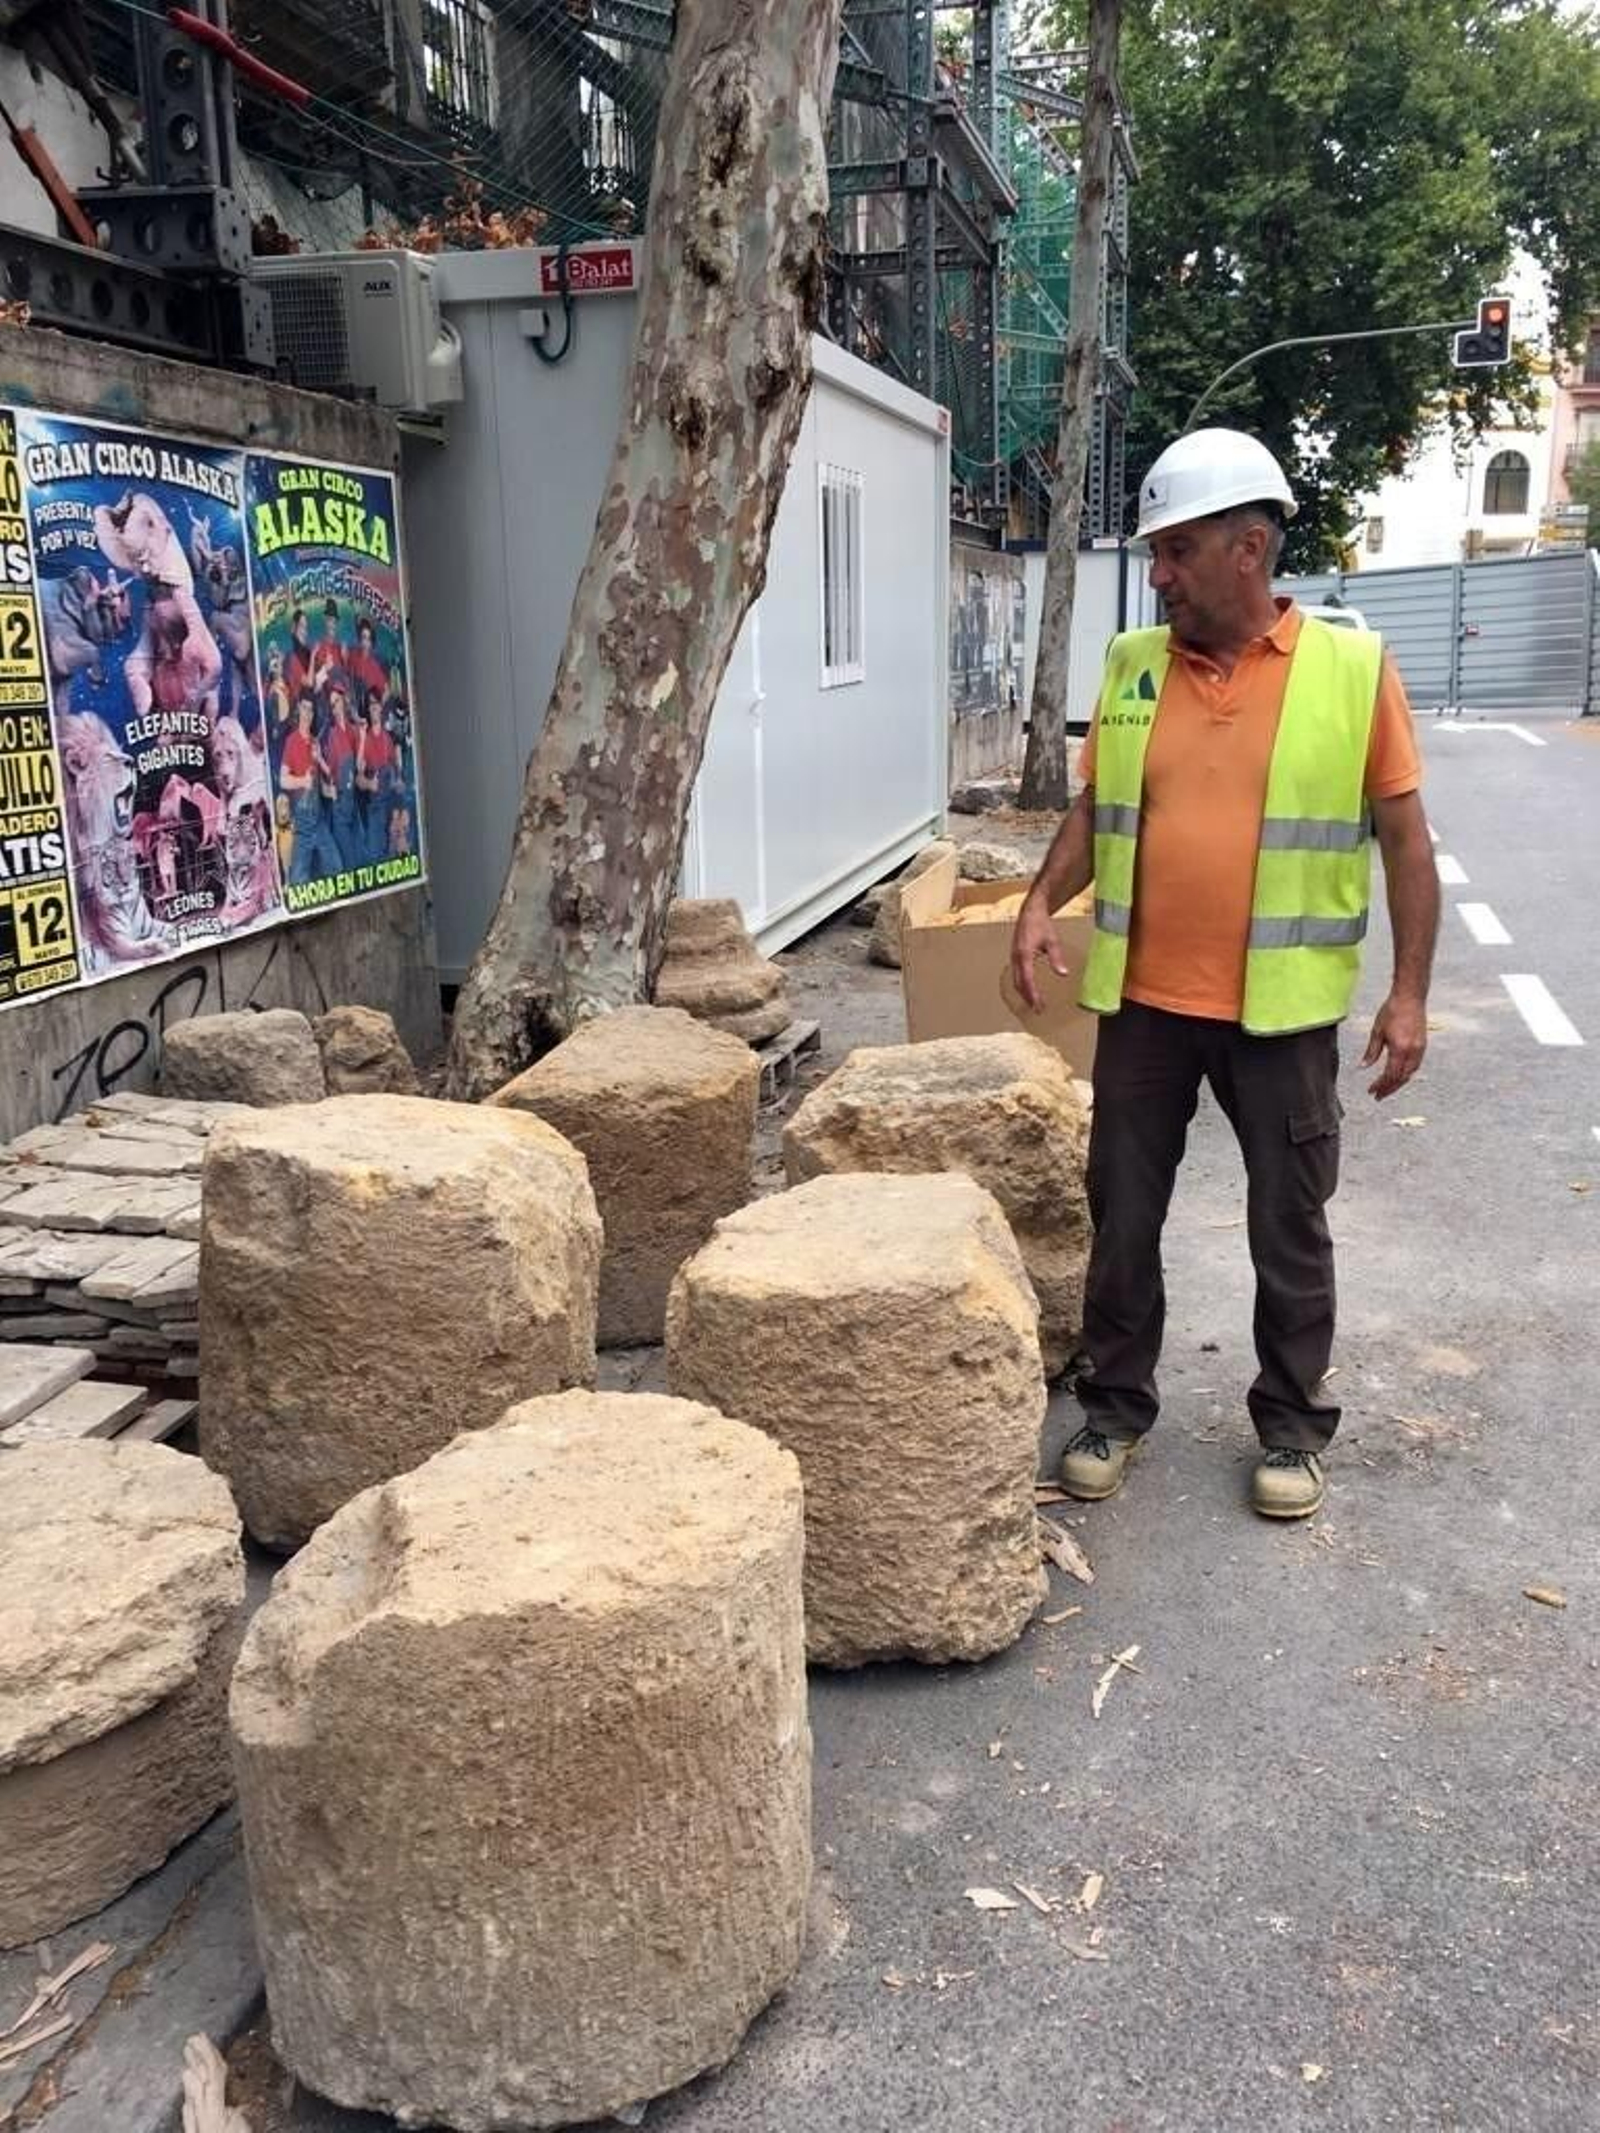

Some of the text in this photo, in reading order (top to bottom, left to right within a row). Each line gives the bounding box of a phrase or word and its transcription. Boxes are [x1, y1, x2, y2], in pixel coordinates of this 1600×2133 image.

[27, 442, 239, 508] GRAN CIRCO ALASKA
[278, 468, 363, 501] GRAN CIRCO
[34, 501, 95, 527] PRESENTA
[41, 530, 64, 555] POR
[75, 529, 97, 550] VEZ
[255, 496, 391, 566] ALASKA
[20, 716, 50, 749] EN:
[125, 711, 208, 745] ELEFANTES
[137, 745, 205, 774] GIGANTES
[288, 855, 419, 910] AHORA EN TU CIUDAD
[164, 891, 215, 920] LEONES
[20, 897, 67, 948] 12
